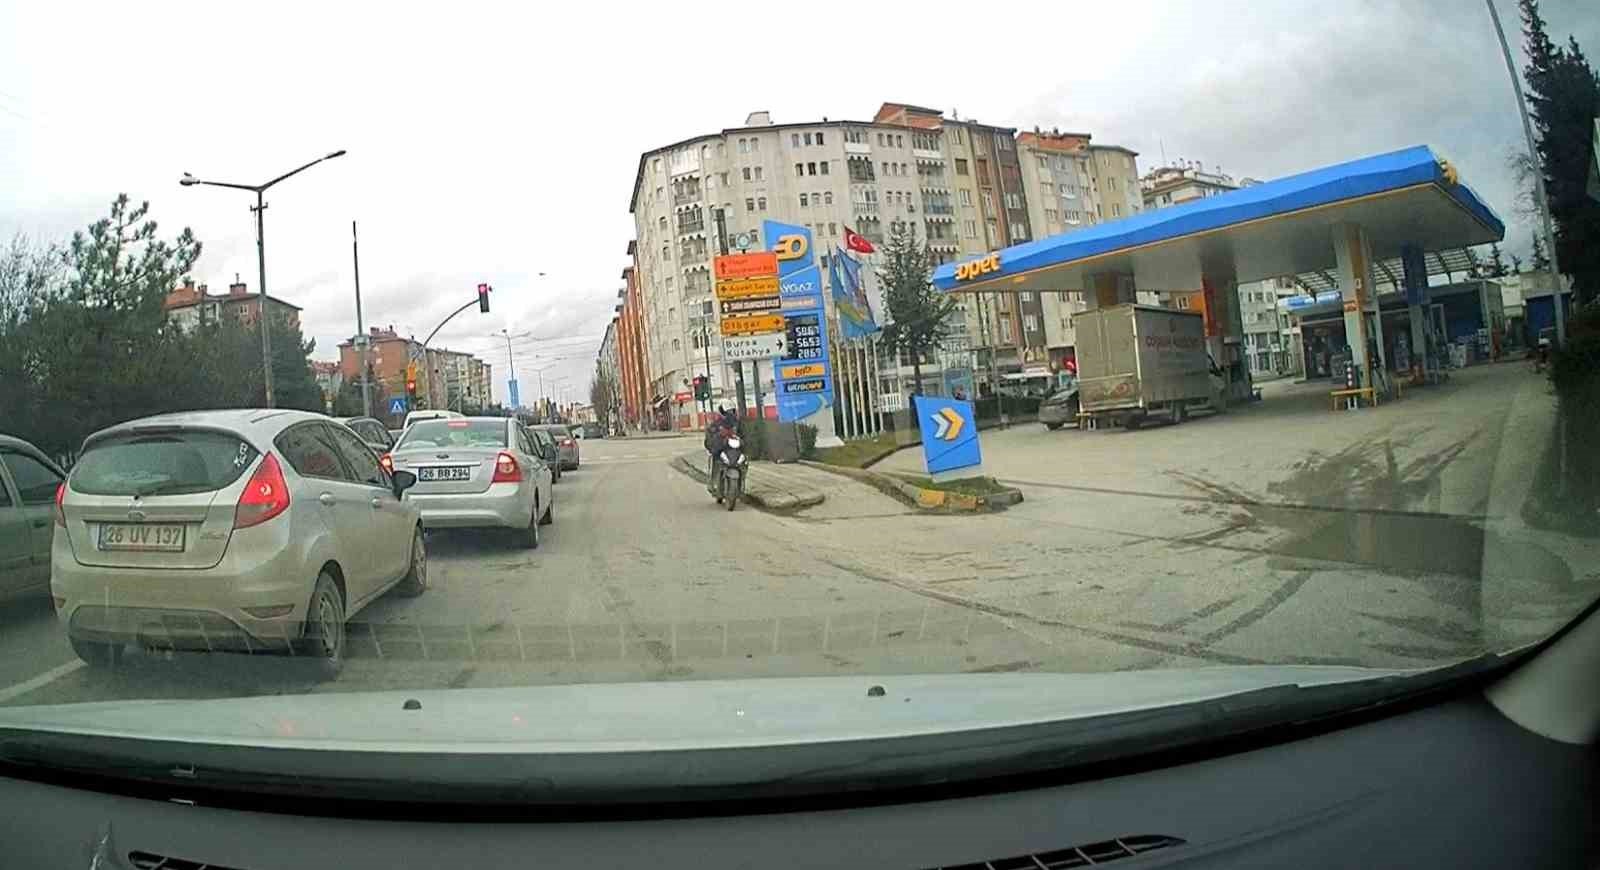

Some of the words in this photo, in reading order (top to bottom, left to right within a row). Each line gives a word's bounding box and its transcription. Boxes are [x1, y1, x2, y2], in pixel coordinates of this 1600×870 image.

[954, 250, 1000, 280] opet
[725, 340, 758, 348] Bursa
[423, 470, 435, 478] 26
[106, 527, 123, 543] 26
[129, 526, 151, 544] UV
[155, 526, 181, 545] 137
